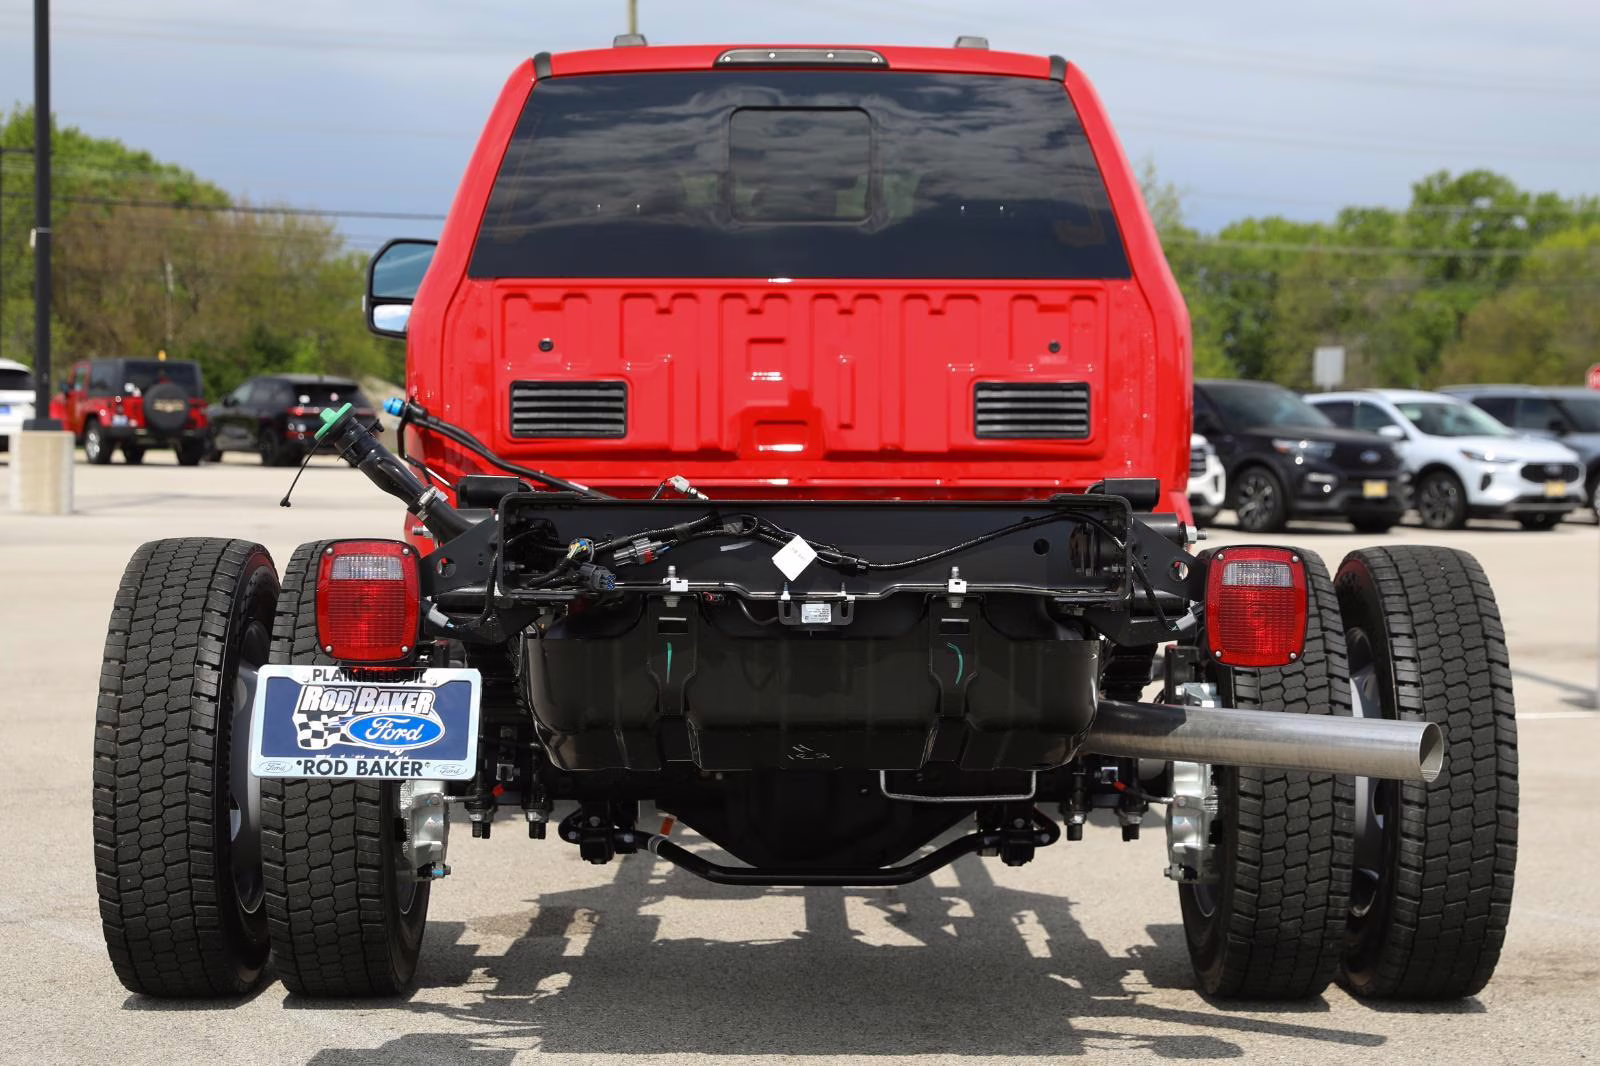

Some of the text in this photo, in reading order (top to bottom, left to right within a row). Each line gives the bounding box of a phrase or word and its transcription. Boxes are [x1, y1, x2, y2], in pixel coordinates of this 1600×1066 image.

[300, 686, 433, 715] ROD BAKER
[365, 718, 425, 741] Ford
[303, 760, 423, 776] ROD BAKER
